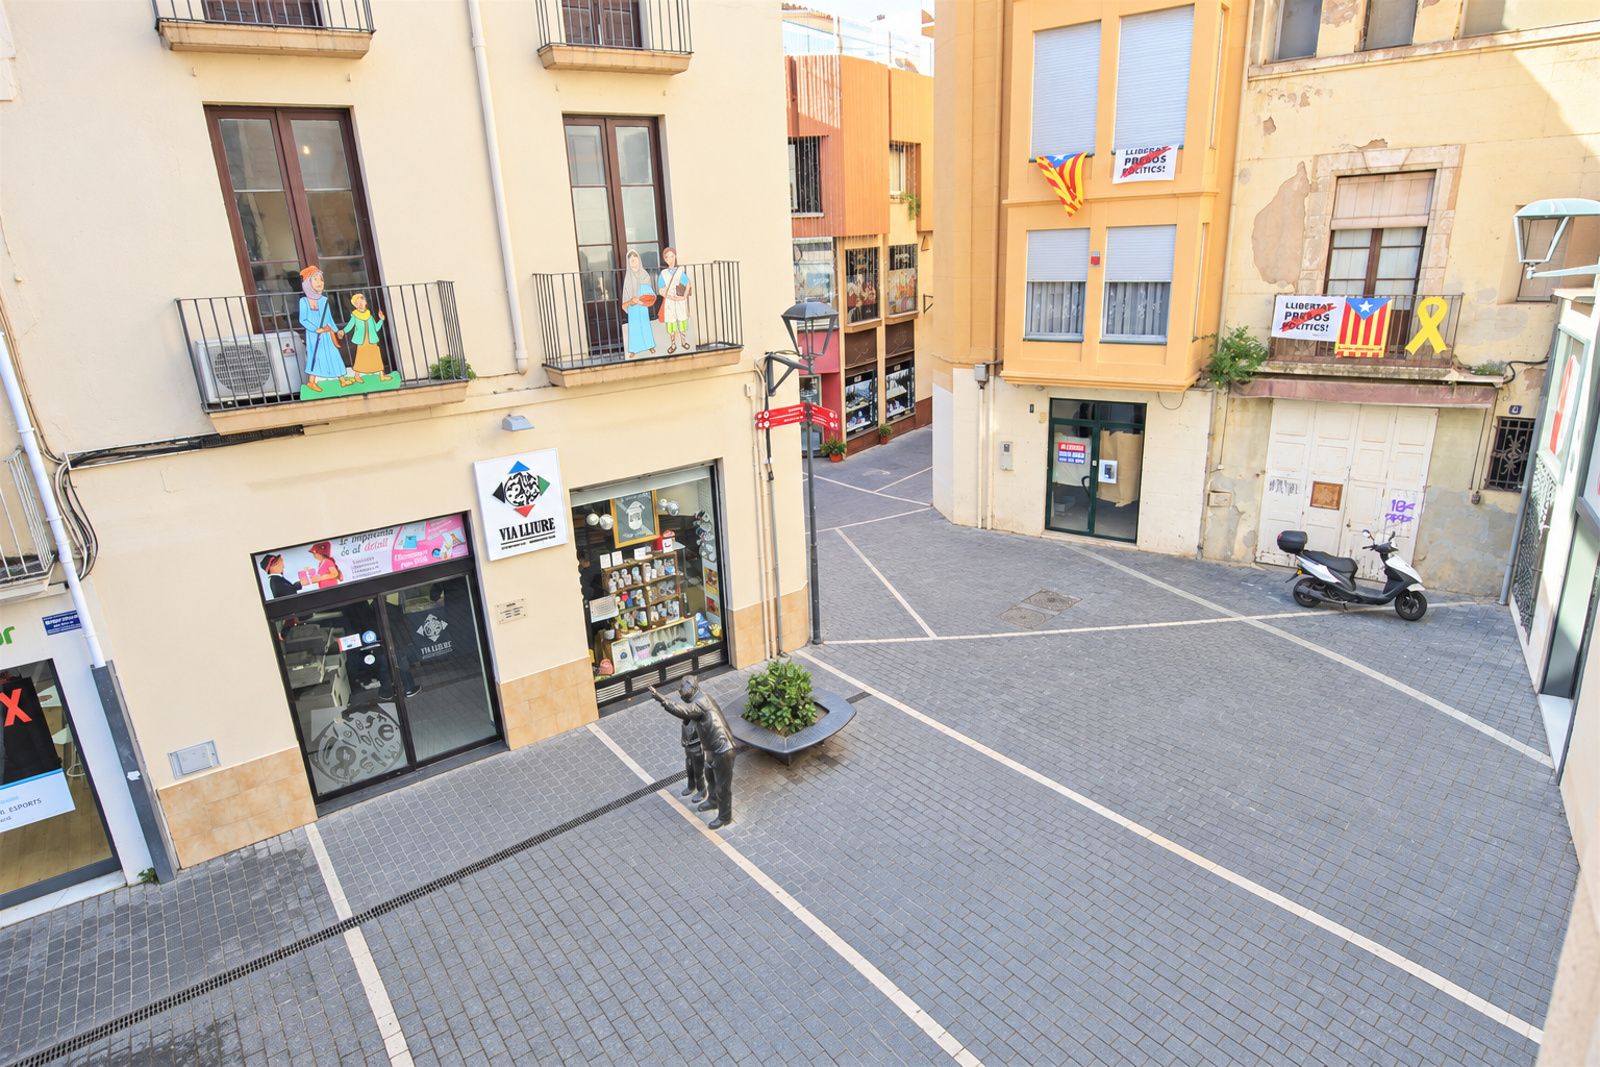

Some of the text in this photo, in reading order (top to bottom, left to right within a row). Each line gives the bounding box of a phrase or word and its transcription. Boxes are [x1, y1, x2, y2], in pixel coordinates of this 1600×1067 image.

[499, 517, 556, 541] VIA LLIURE
[9, 797, 42, 813] ESPORTS
